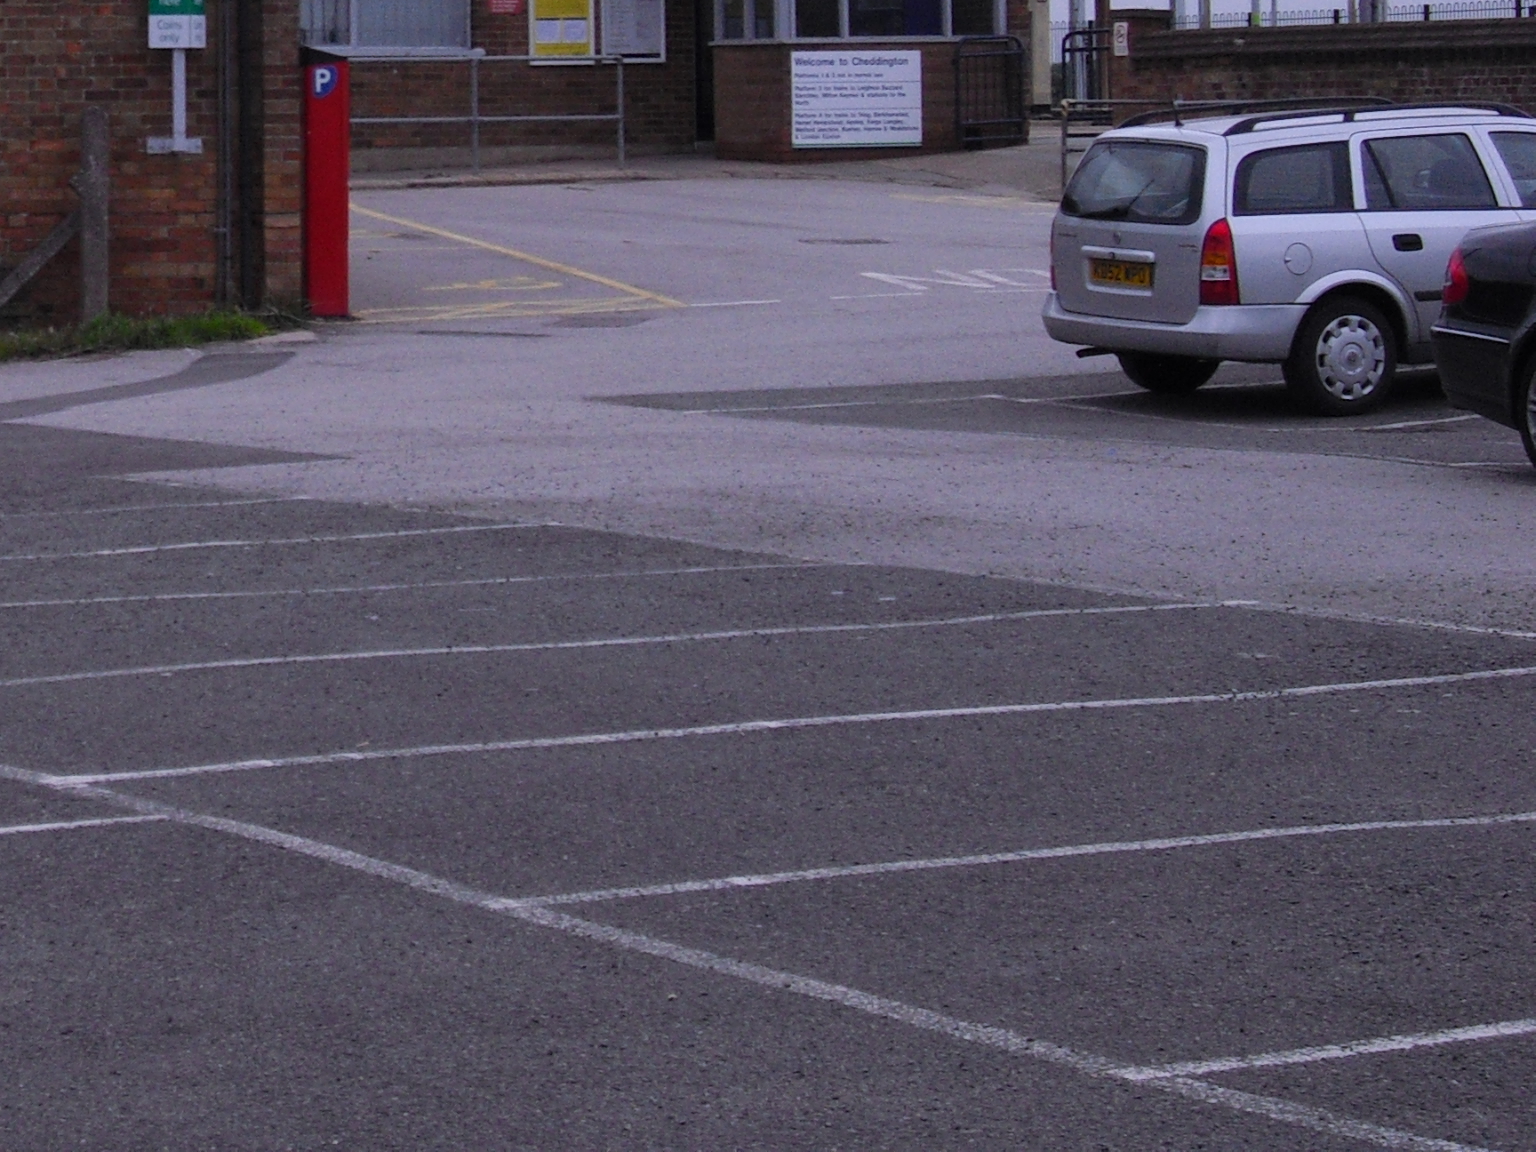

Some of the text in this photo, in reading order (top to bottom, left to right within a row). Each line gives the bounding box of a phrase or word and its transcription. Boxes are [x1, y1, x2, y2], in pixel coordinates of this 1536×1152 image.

[794, 57, 909, 67] Welcome to Cheddington
[314, 67, 332, 94] P
